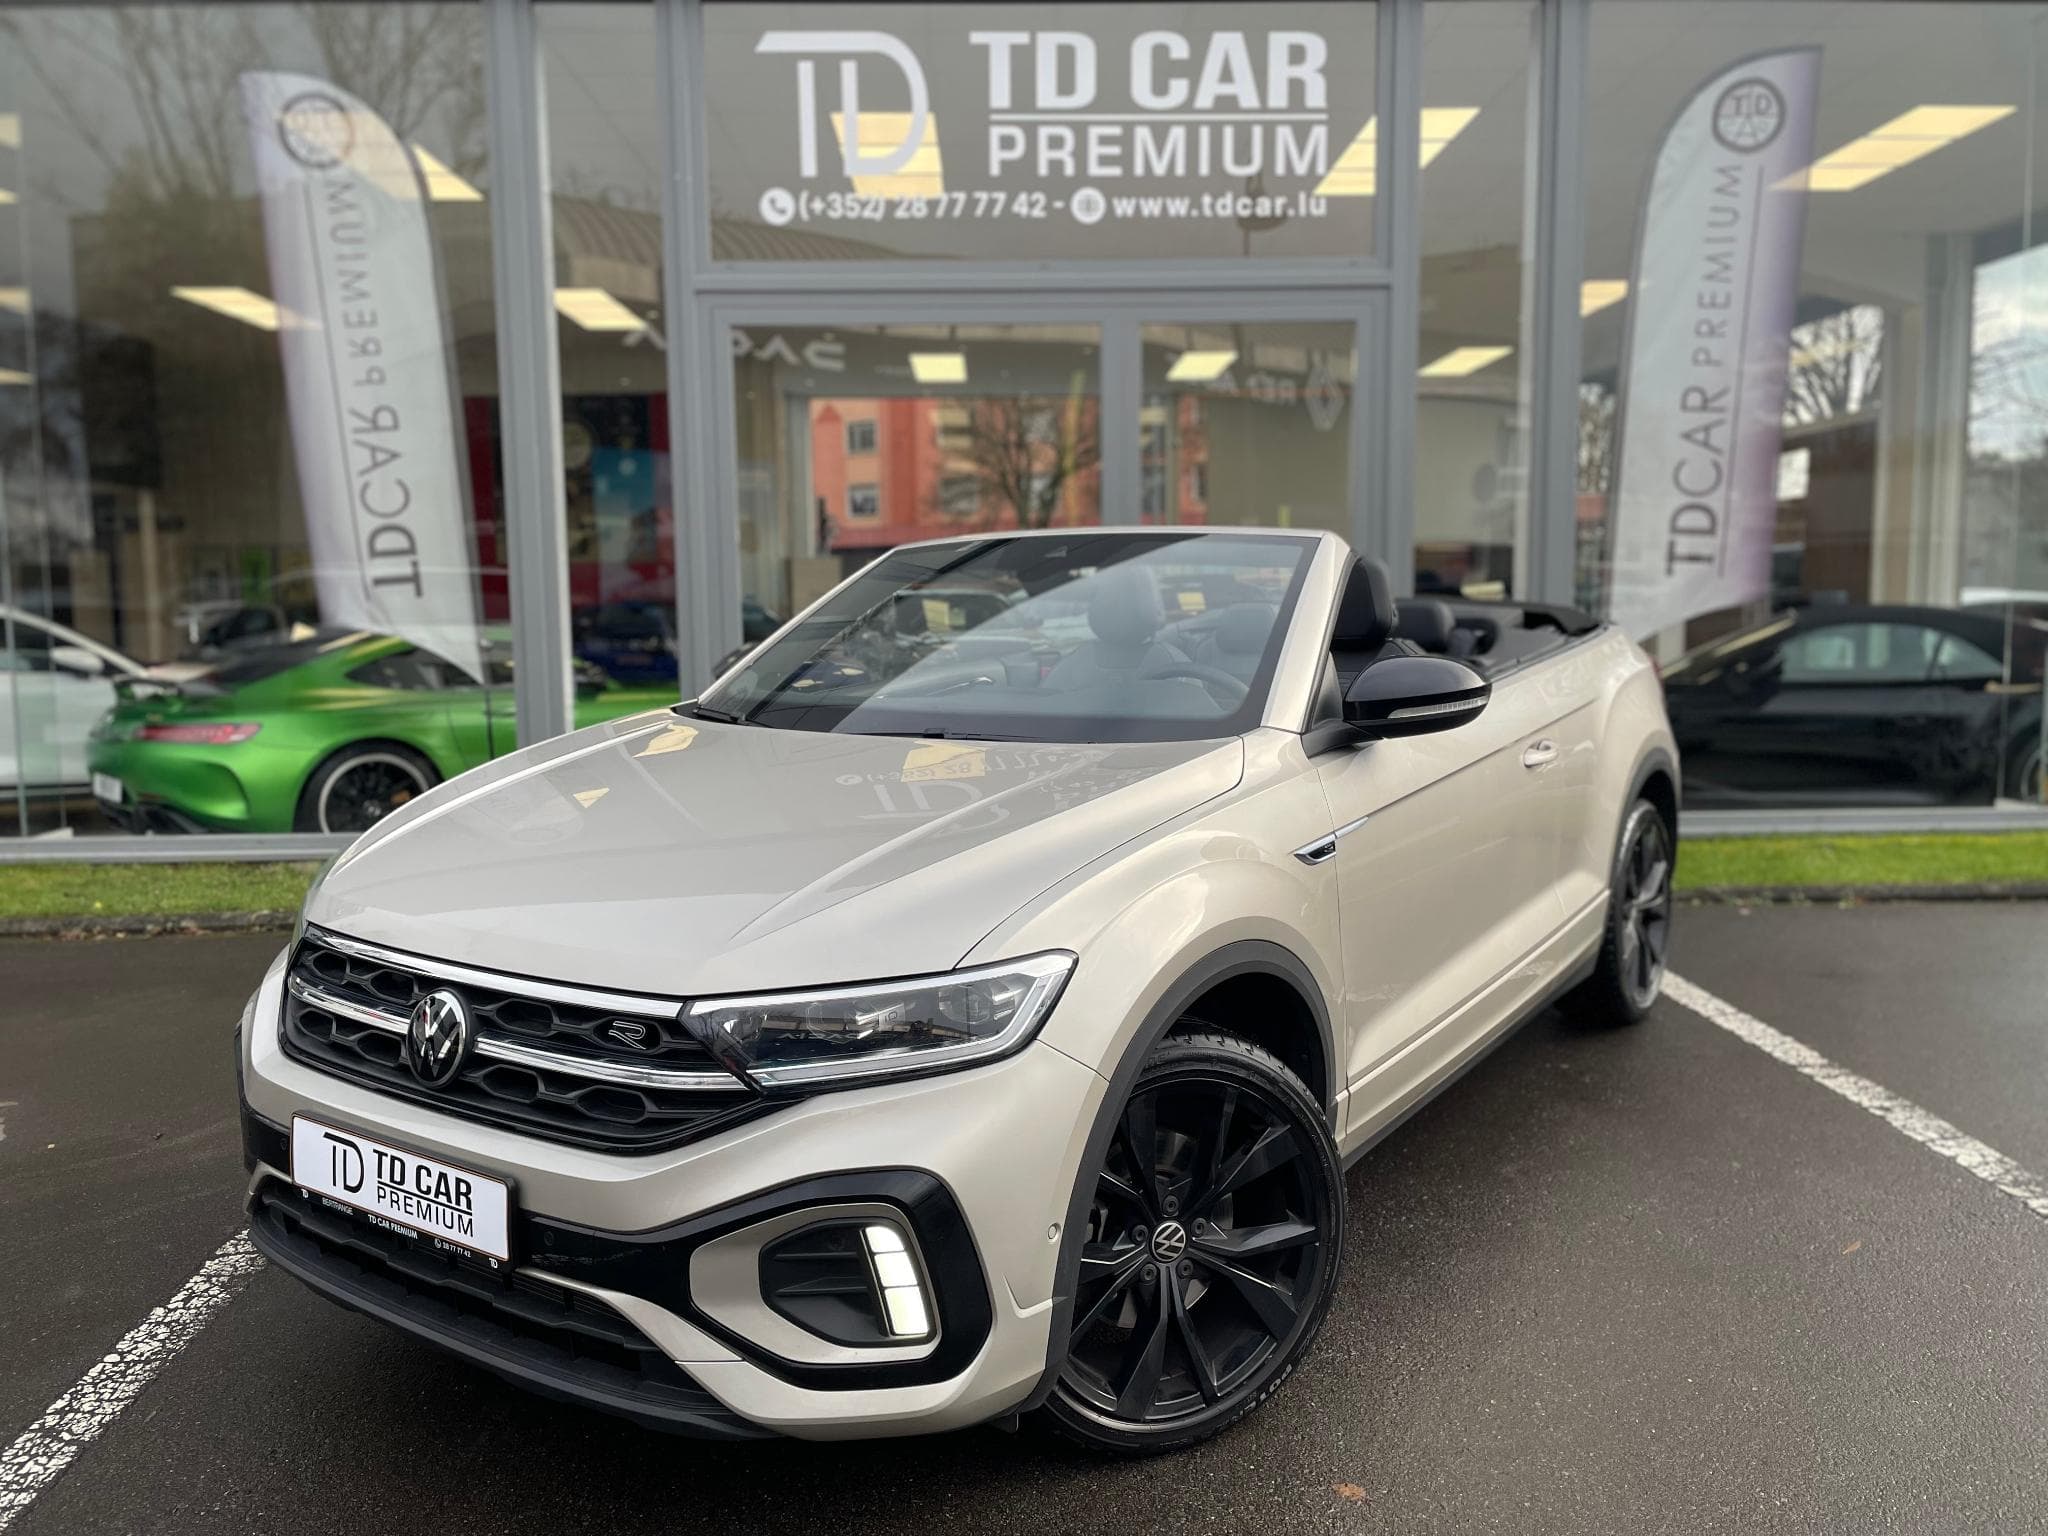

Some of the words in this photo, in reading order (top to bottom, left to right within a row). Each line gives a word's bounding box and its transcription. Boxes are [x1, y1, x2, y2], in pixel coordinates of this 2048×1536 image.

[970, 32, 1097, 109] TD
[1130, 31, 1327, 109] CAR
[989, 125, 1328, 177] PREMIUM
[799, 191, 885, 221] (+352)
[894, 194, 929, 219] 28
[935, 192, 967, 218] 77
[973, 192, 1008, 218] 77
[1011, 191, 1047, 218] 42
[1112, 191, 1328, 218] www.tdcar.lu
[1696, 163, 1743, 369] PREMIUM
[1665, 387, 1730, 577] TDCAR
[373, 1149, 405, 1187] TD
[415, 1164, 472, 1211] CAR
[367, 1214, 377, 1224] TD
[378, 1217, 390, 1230] CAR
[390, 1222, 418, 1240] PREMIUM
[377, 1186, 474, 1238] PREMIUM
